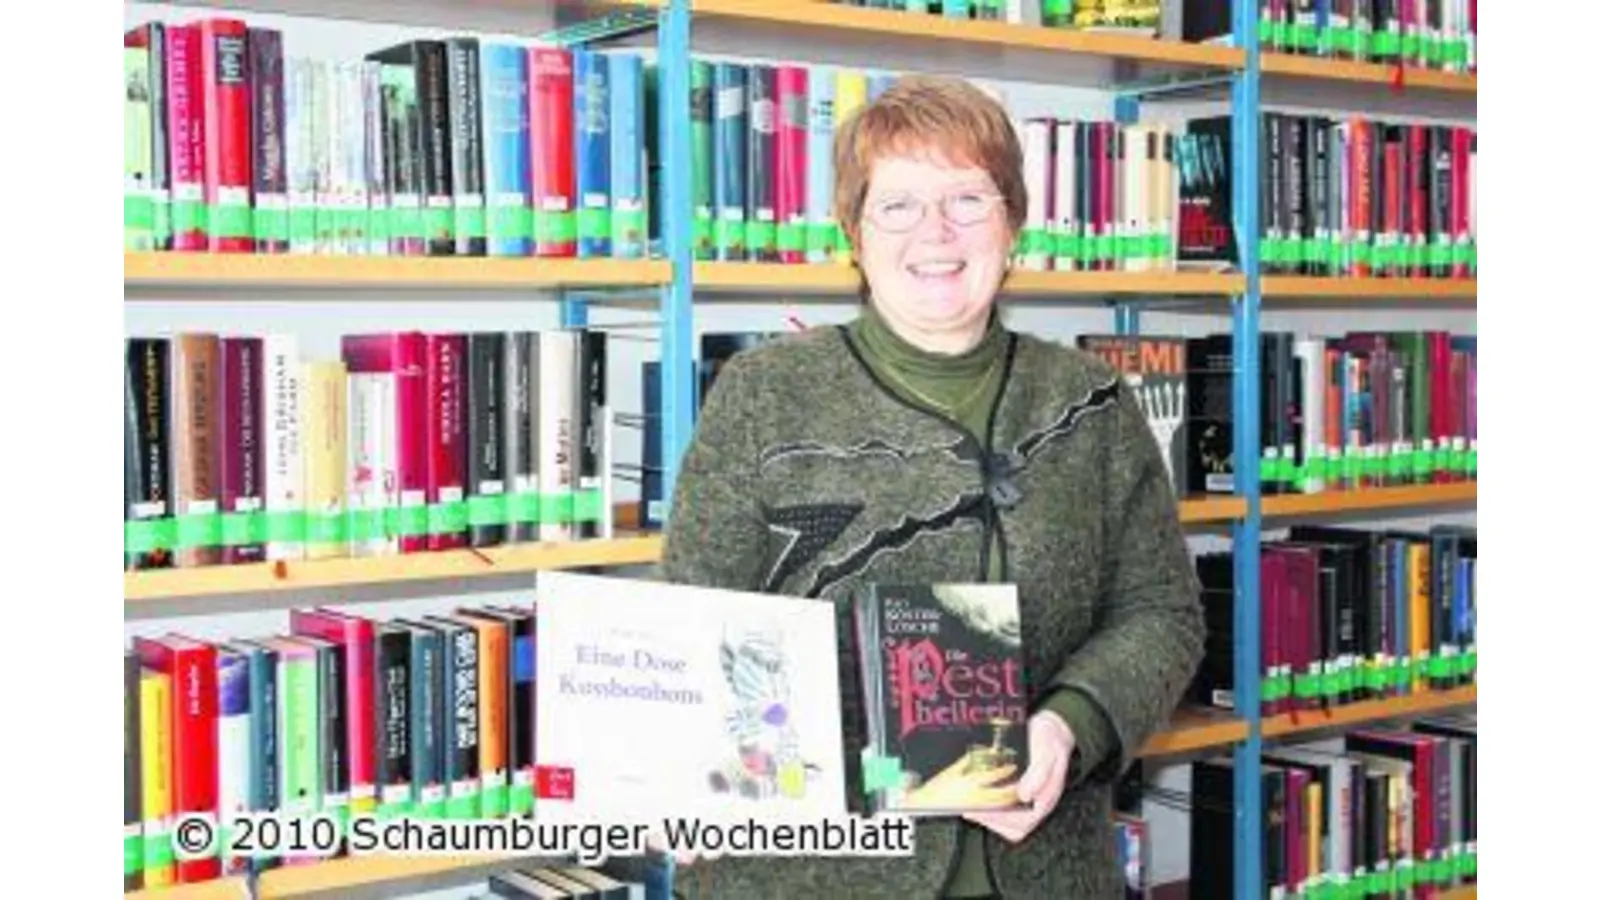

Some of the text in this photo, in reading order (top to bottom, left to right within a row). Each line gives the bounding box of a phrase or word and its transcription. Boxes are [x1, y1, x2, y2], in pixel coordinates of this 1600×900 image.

[575, 643, 688, 673] Eine Dose
[893, 638, 1019, 739] Pest
